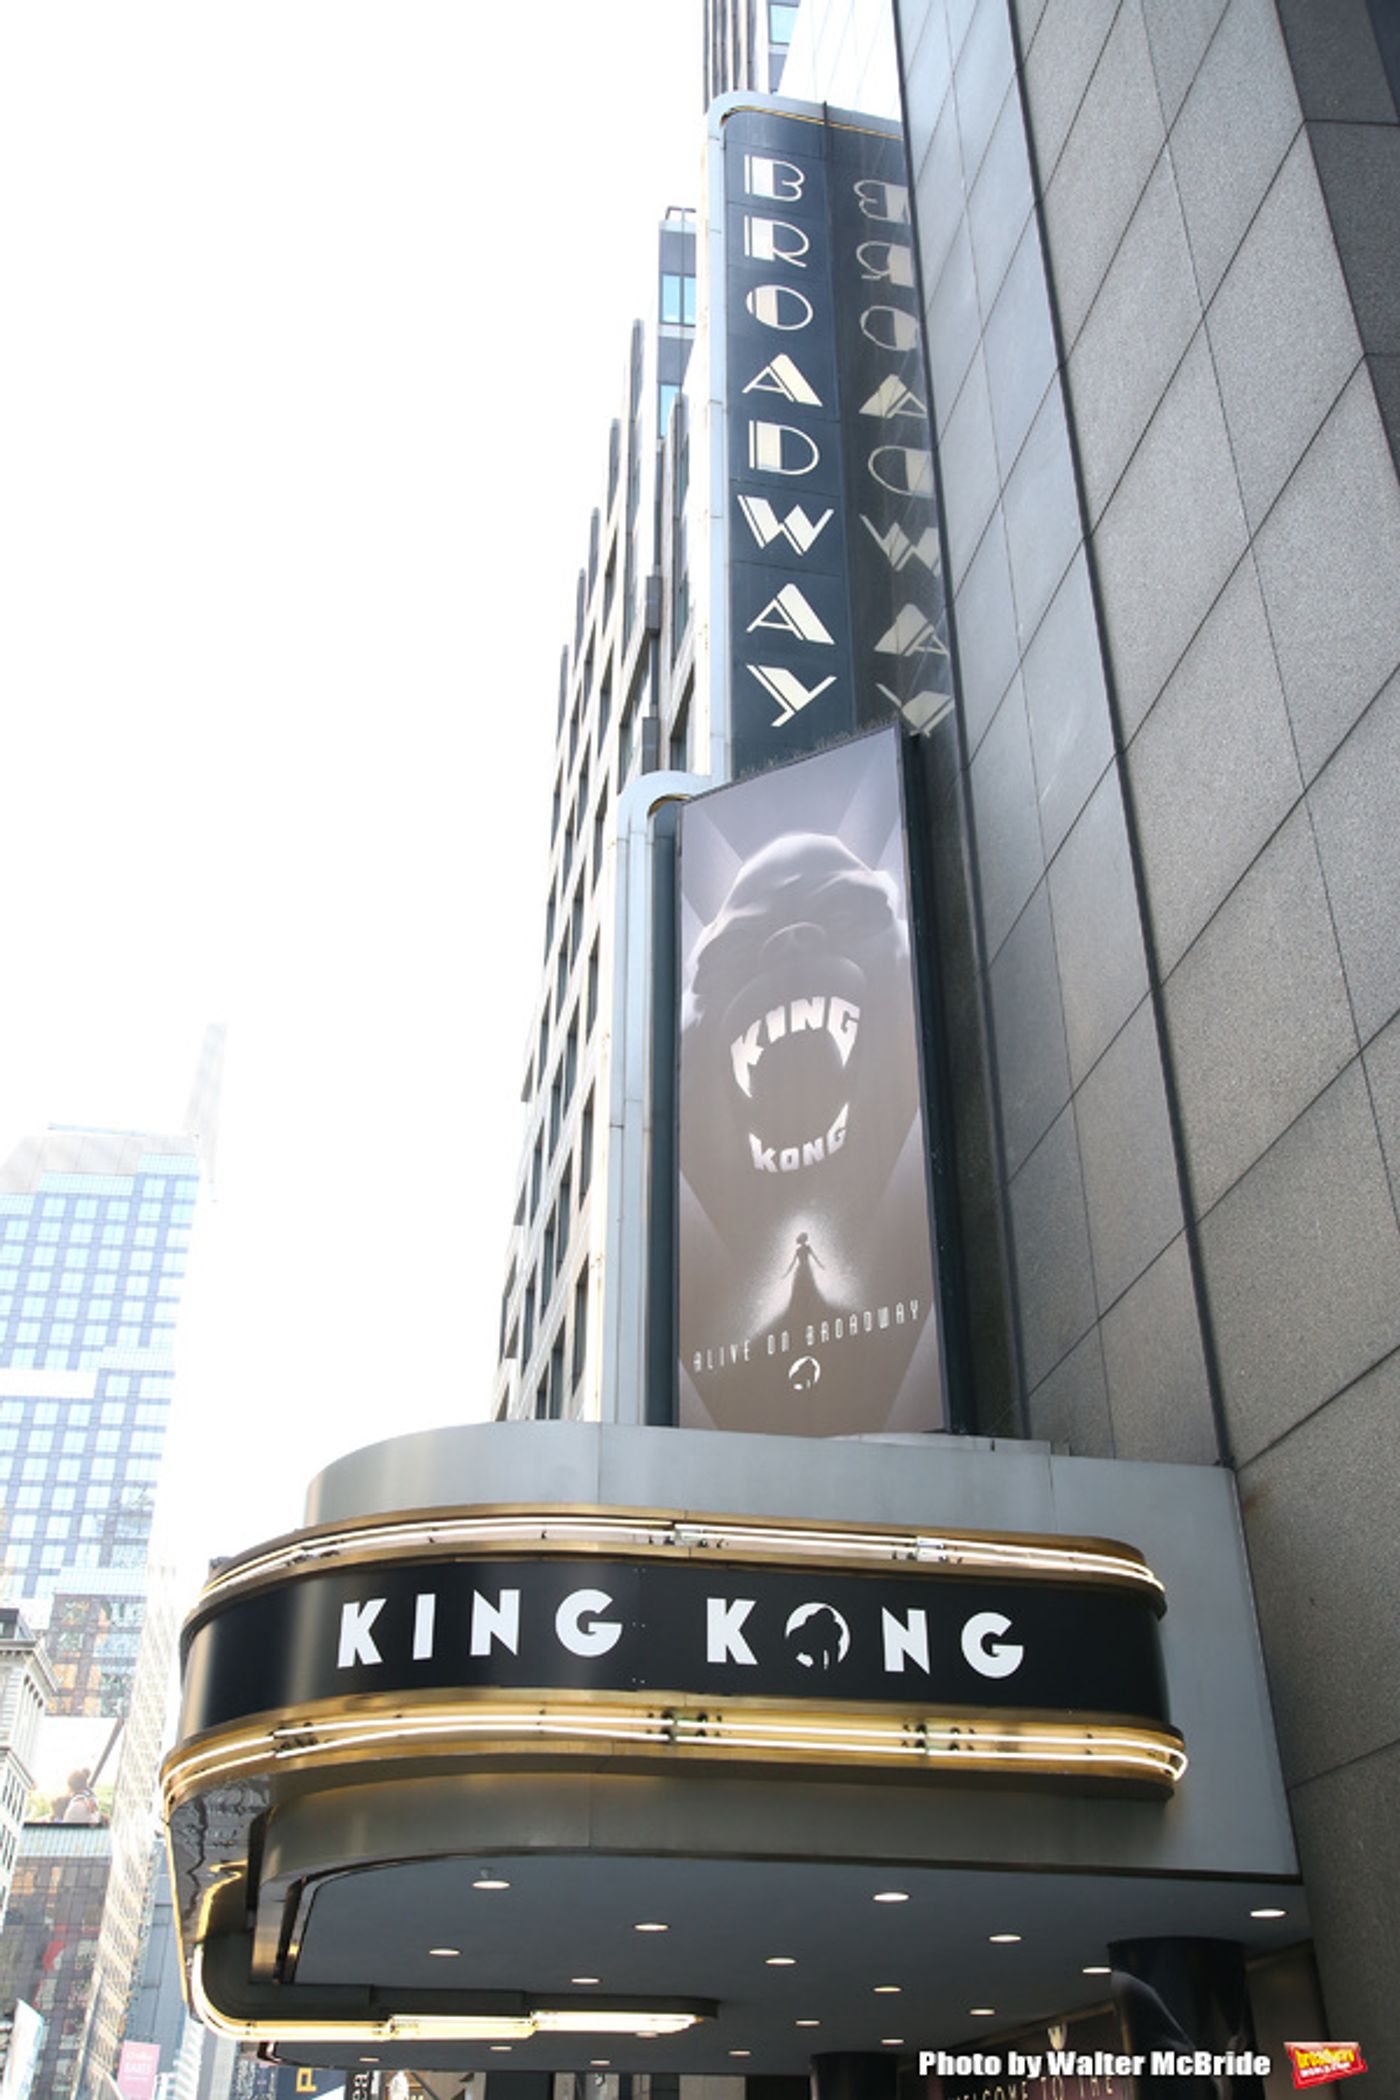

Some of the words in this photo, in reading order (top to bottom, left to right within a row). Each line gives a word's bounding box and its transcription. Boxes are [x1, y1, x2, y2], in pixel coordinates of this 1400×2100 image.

[737, 155, 837, 727] BROADWAY
[730, 995, 860, 1098] KING
[748, 1102, 849, 1173] KONG
[693, 1338, 751, 1372] ALIVE
[767, 1330, 790, 1356] ON
[805, 1299, 920, 1346] BROADWAY
[337, 1588, 623, 1669] KING
[706, 1597, 1024, 1679] KONG
